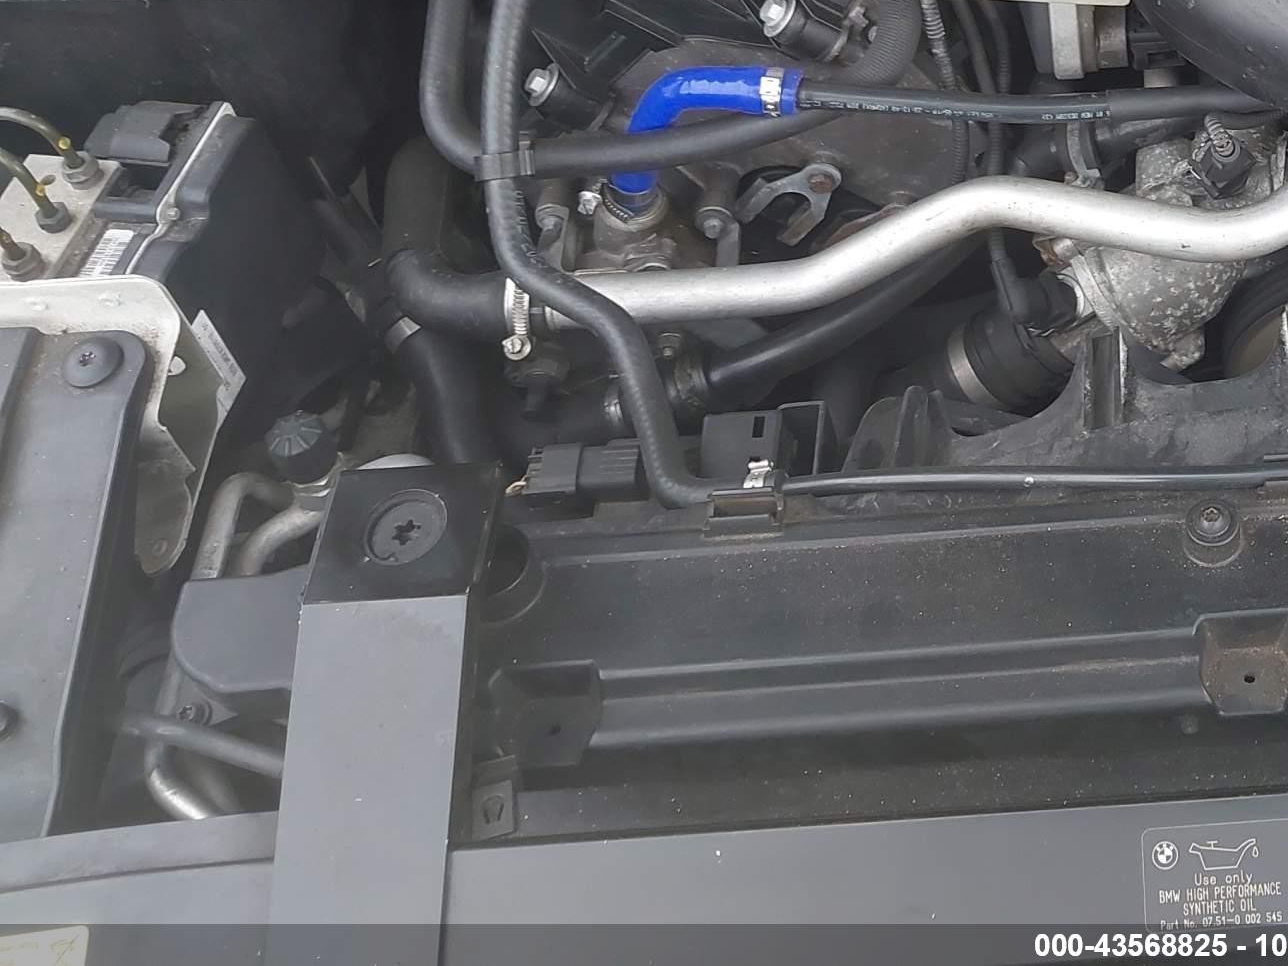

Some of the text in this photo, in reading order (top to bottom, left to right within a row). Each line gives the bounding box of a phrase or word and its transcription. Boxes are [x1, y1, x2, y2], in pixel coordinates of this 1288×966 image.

[1194, 870, 1253, 886] Use only
[1159, 882, 1282, 904] BMW HIGH PERFORMANCE
[1183, 898, 1257, 916] SYNTHETIC OIL
[1160, 919, 1179, 931] Part
[1202, 914, 1241, 927] 07.51-0
[1245, 913, 1261, 924] 002
